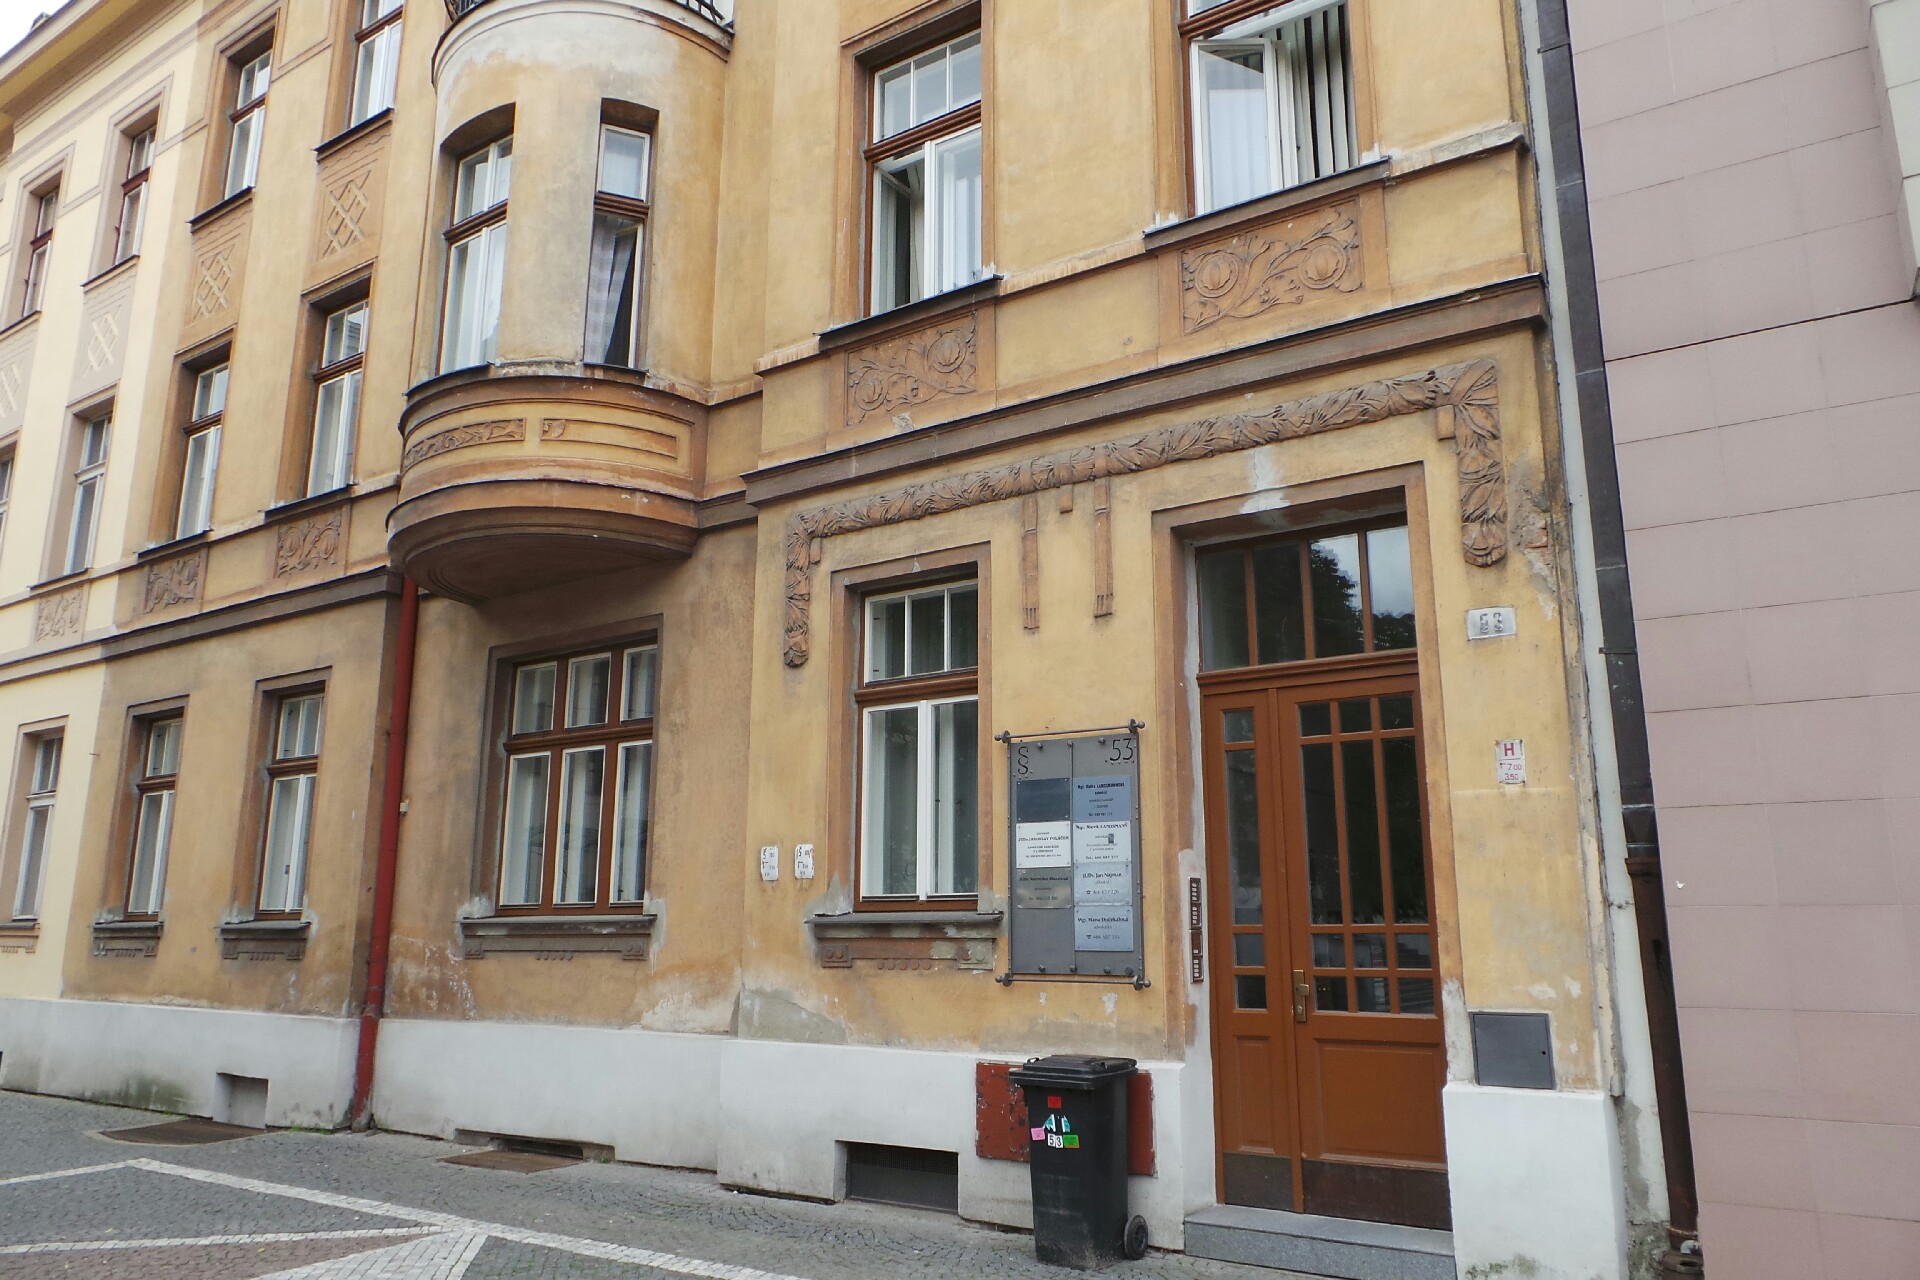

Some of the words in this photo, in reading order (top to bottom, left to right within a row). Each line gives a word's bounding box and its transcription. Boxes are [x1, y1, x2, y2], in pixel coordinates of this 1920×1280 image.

[1109, 738, 1134, 762] 53
[1503, 743, 1515, 757] H
[1049, 1134, 1062, 1147] 53
